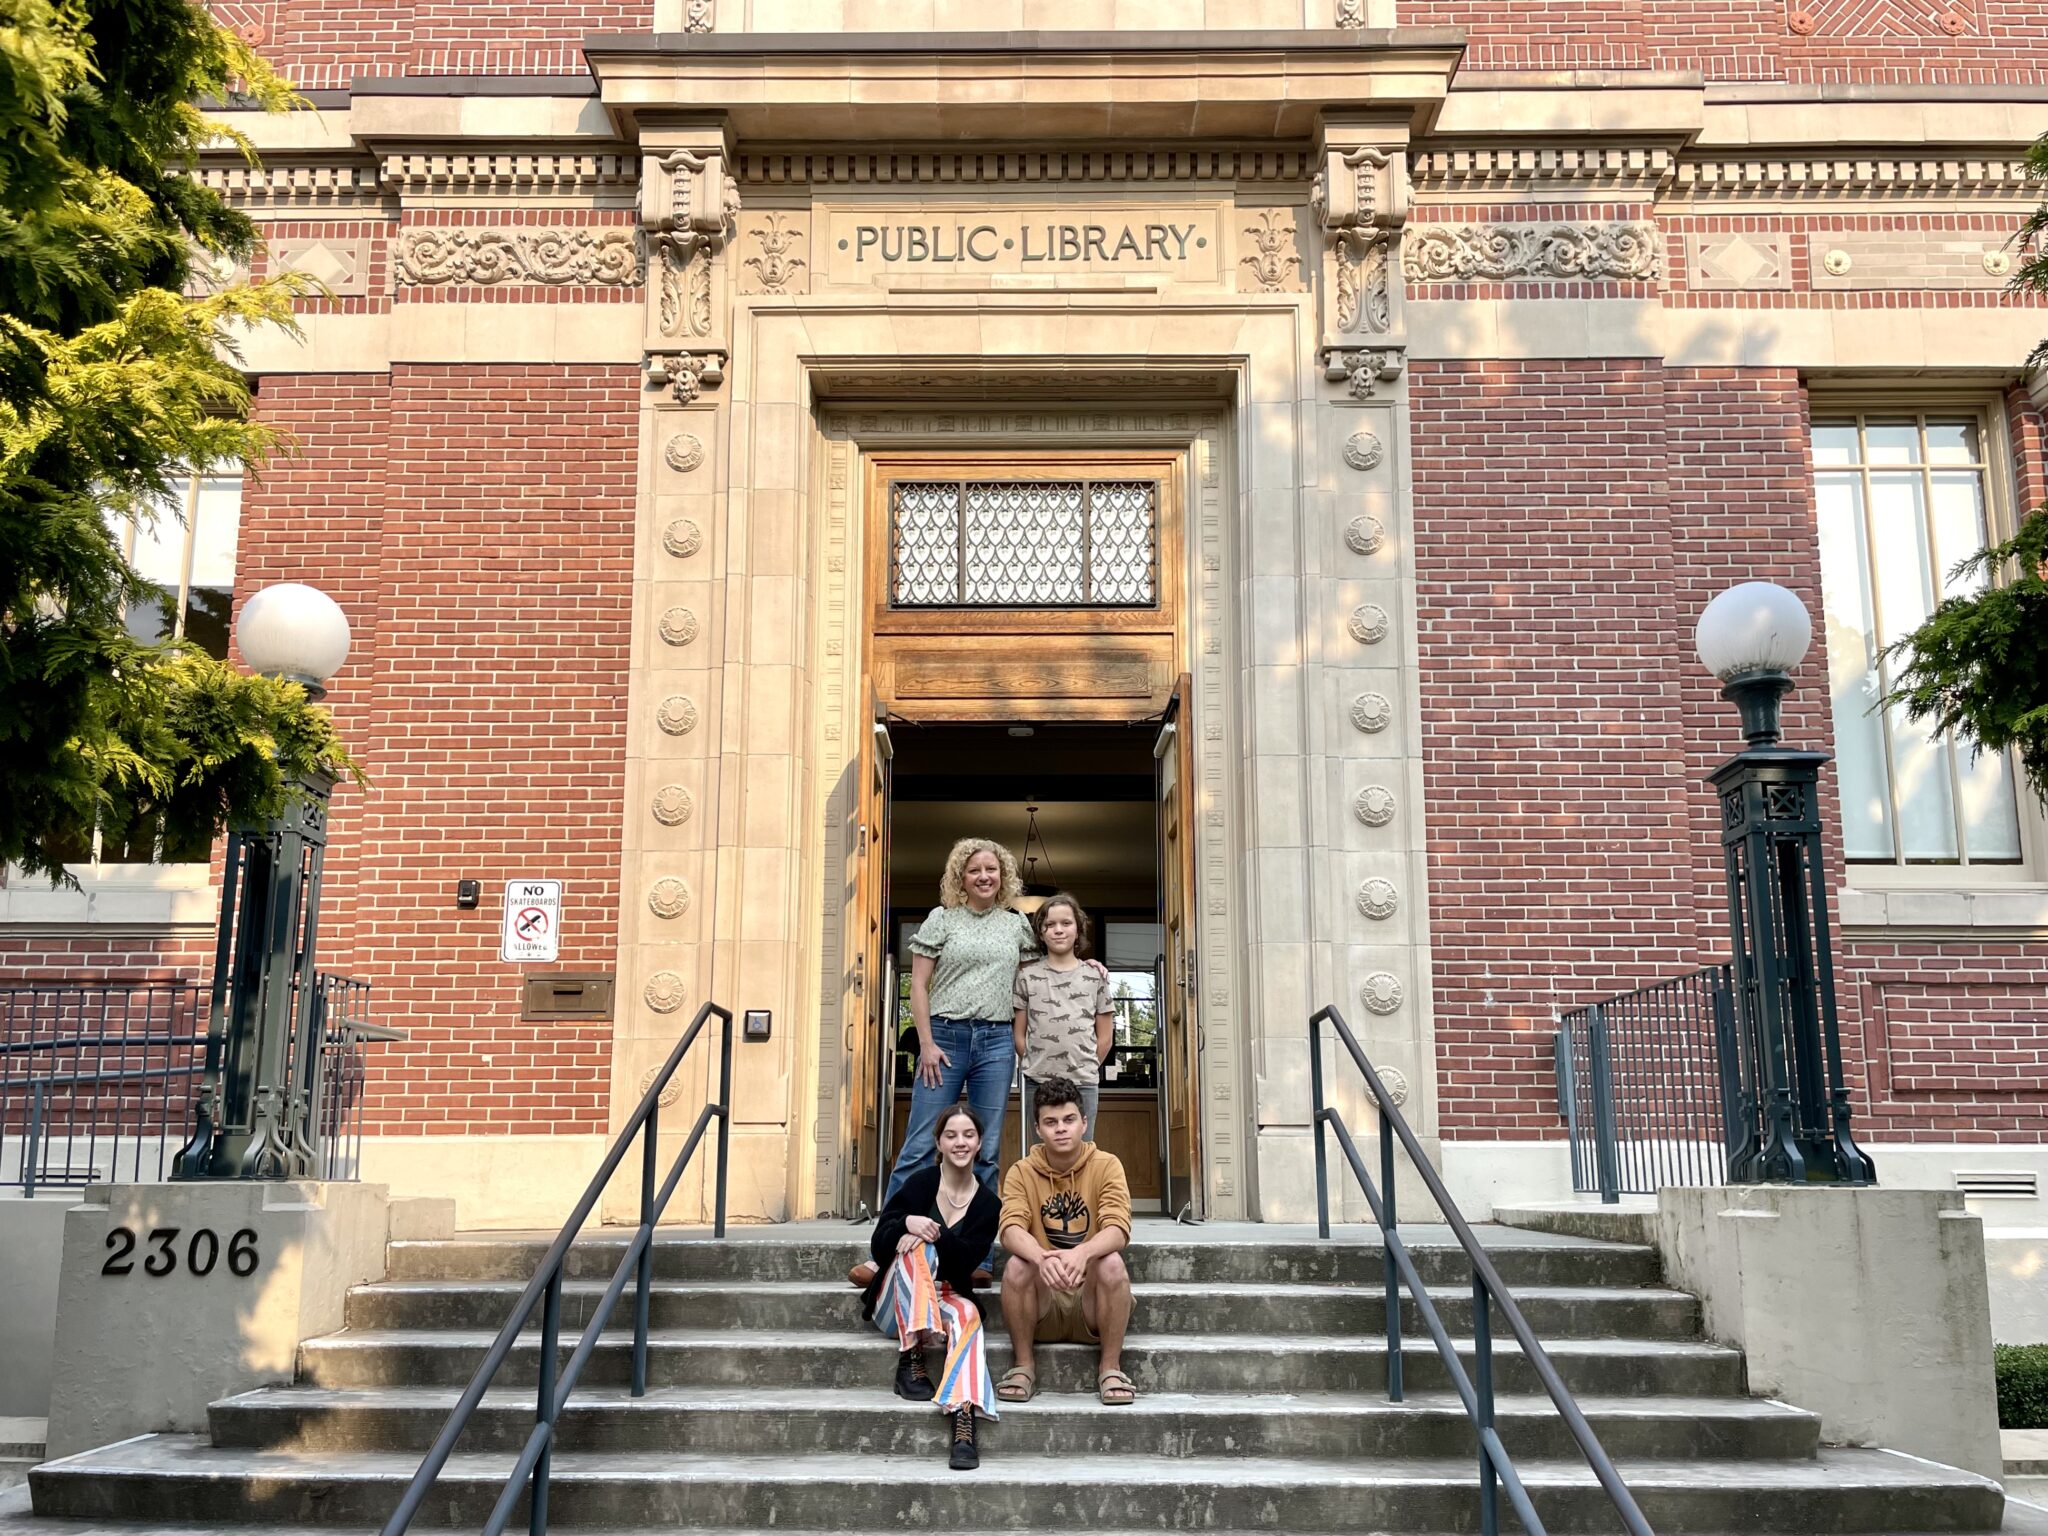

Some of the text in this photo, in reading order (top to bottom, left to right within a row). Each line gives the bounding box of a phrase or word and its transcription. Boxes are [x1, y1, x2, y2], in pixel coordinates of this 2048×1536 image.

[856, 224, 1196, 262] PUBLIC LIBRARY
[510, 897, 556, 906] SKATEBOARDS
[523, 885, 544, 896] NO
[101, 1227, 260, 1277] 2306
